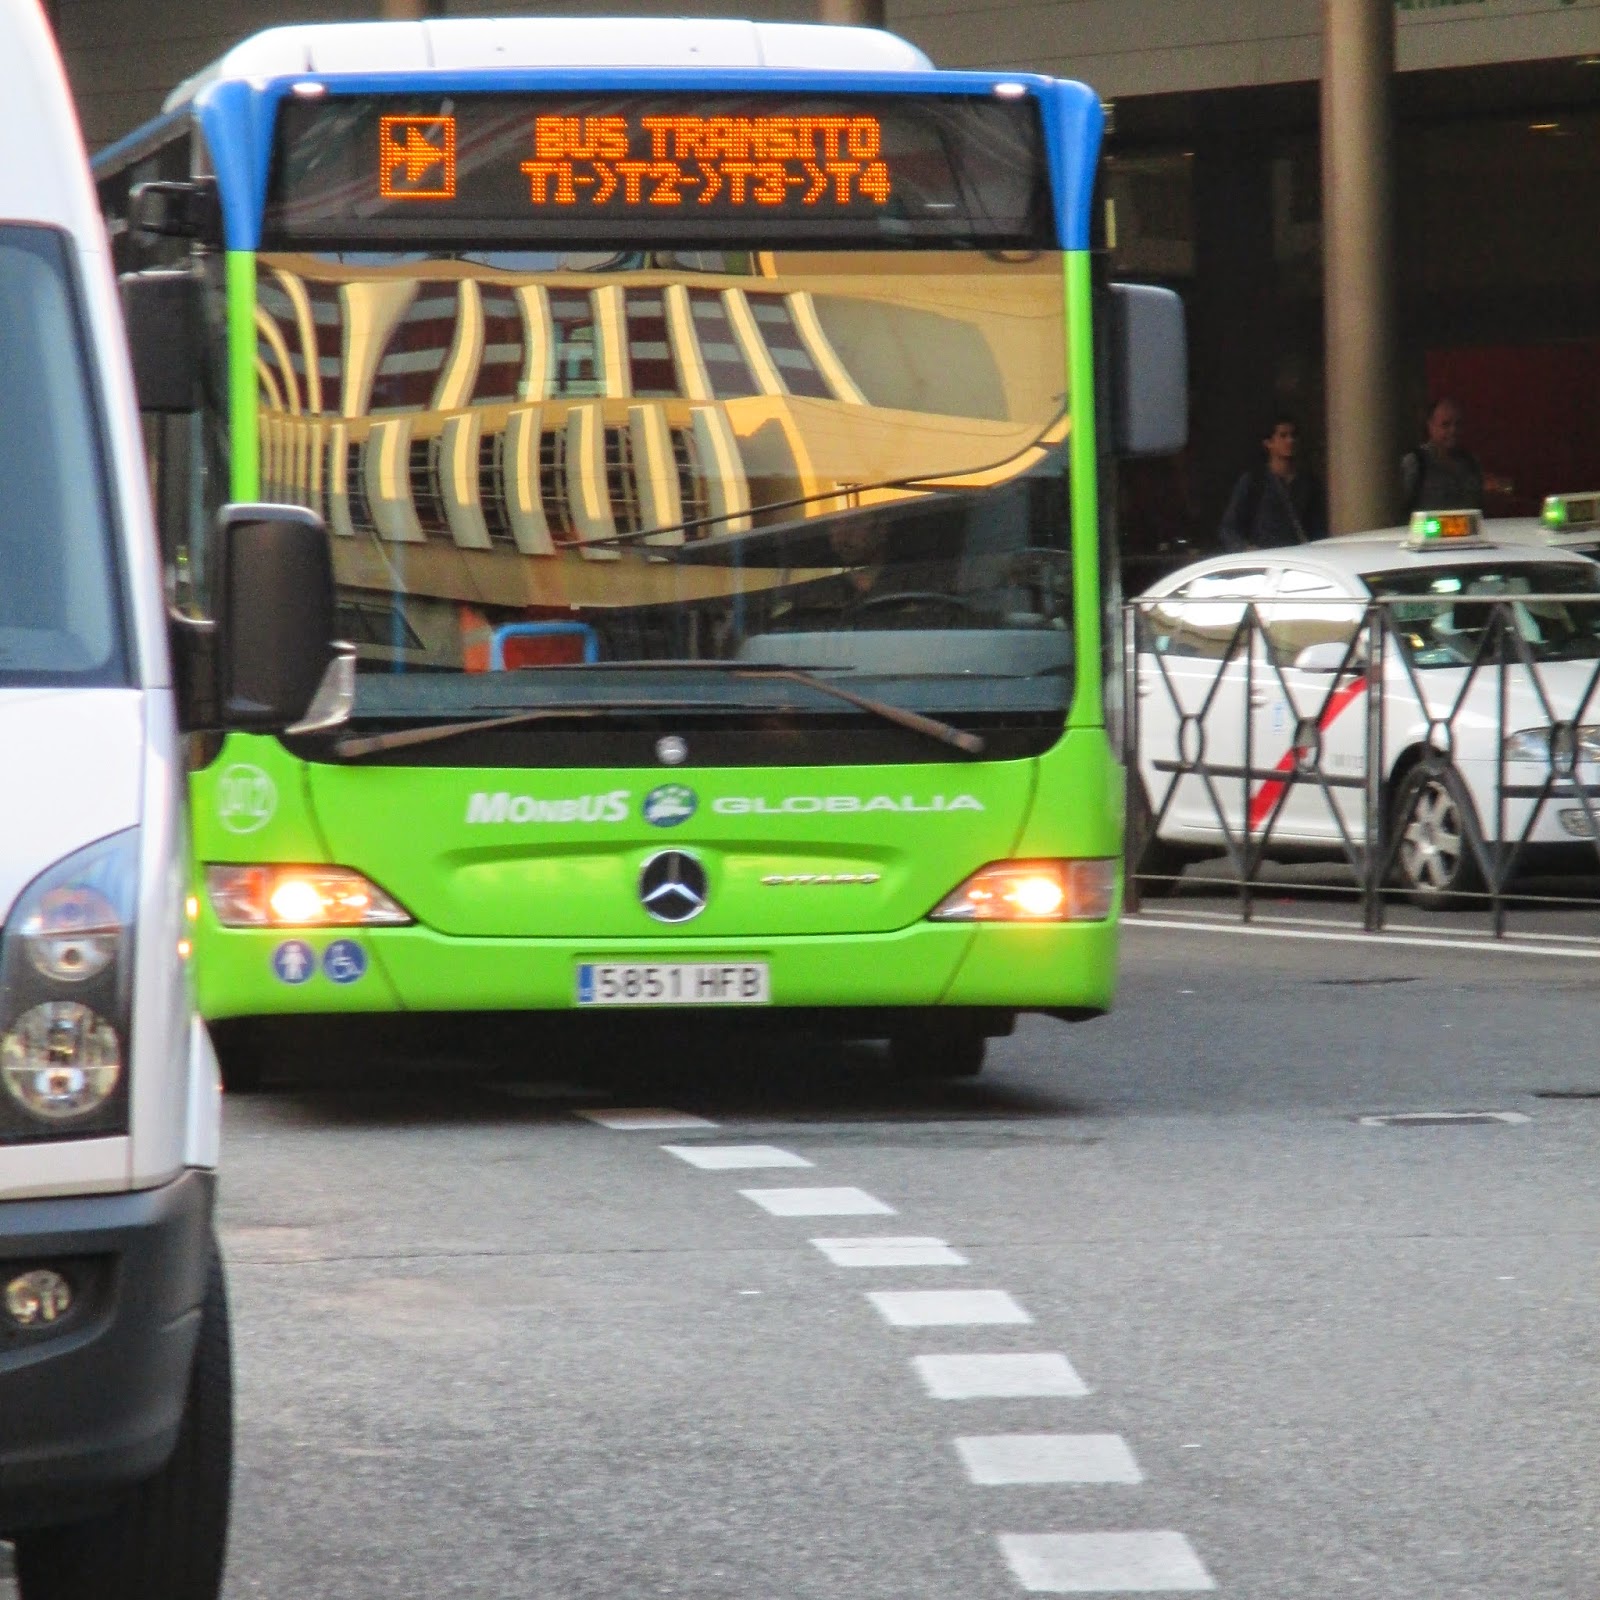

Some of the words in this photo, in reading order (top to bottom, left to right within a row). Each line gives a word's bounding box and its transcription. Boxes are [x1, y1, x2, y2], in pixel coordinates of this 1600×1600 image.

[534, 116, 628, 159] BUS
[641, 116, 881, 159] TRANSITO
[711, 794, 986, 814] GLOBALIA
[600, 967, 682, 998] 5851
[695, 967, 761, 998] HFB
